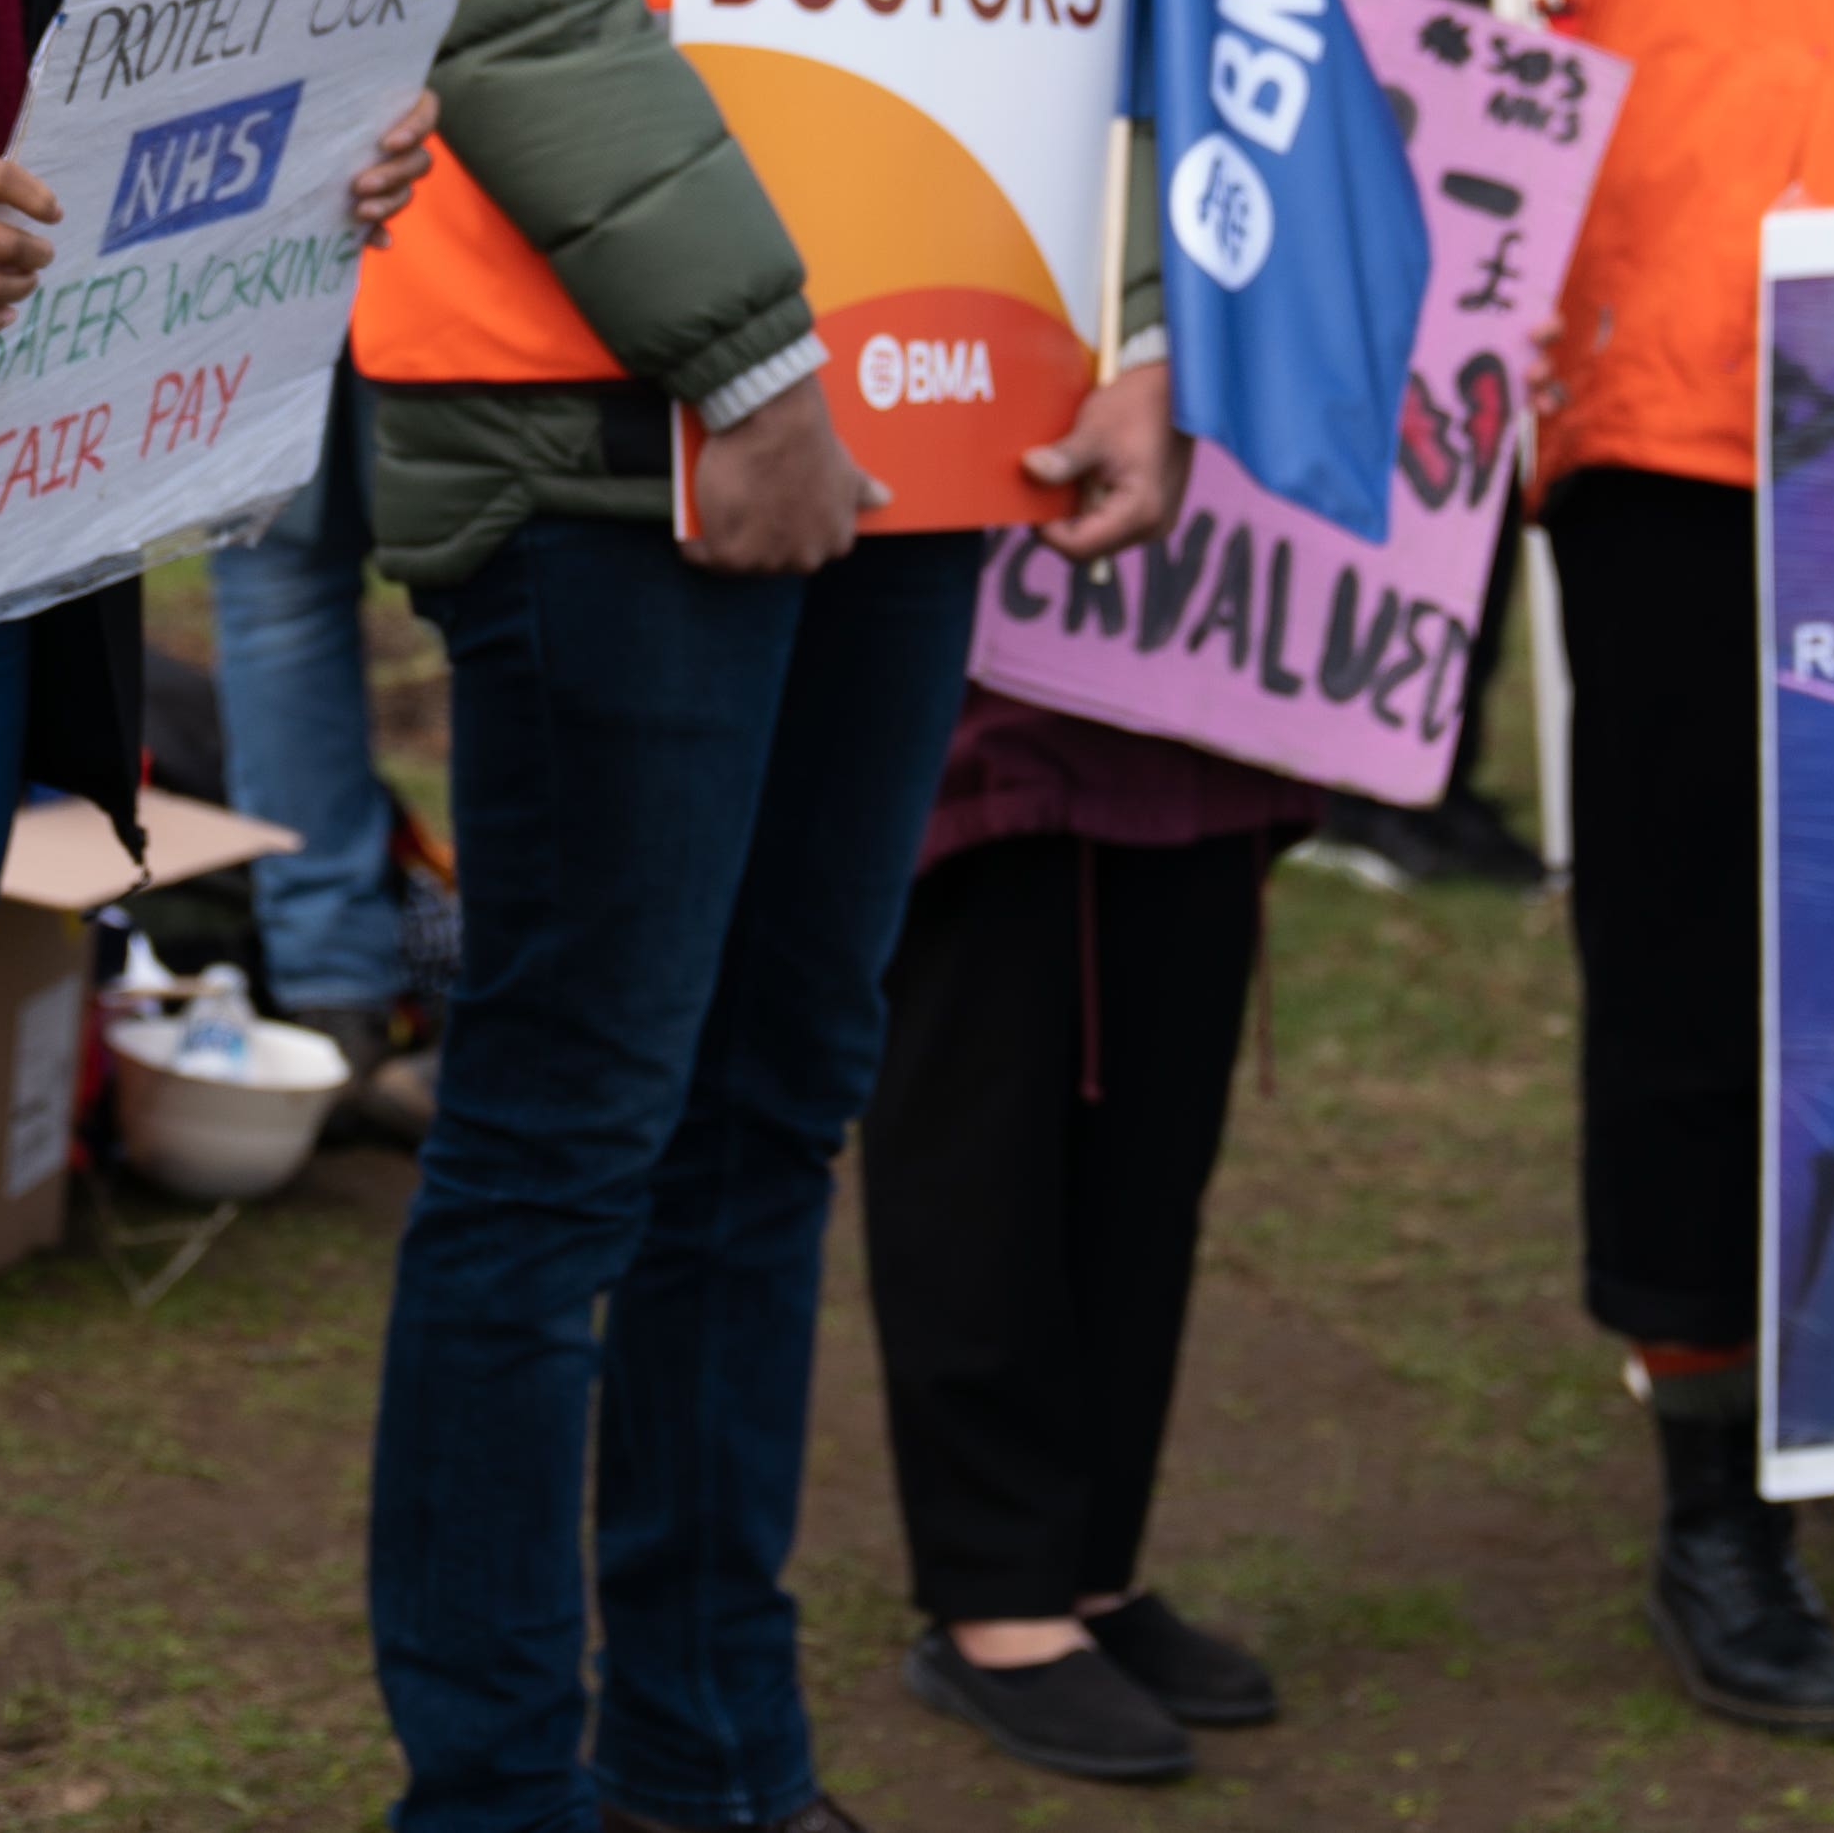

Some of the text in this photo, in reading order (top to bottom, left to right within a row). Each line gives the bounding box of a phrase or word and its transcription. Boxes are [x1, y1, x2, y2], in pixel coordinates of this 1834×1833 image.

[117, 107, 276, 229] NHS
[162, 229, 359, 335] WORKING
[140, 355, 251, 459] PAY
[906, 339, 995, 405] BMA
